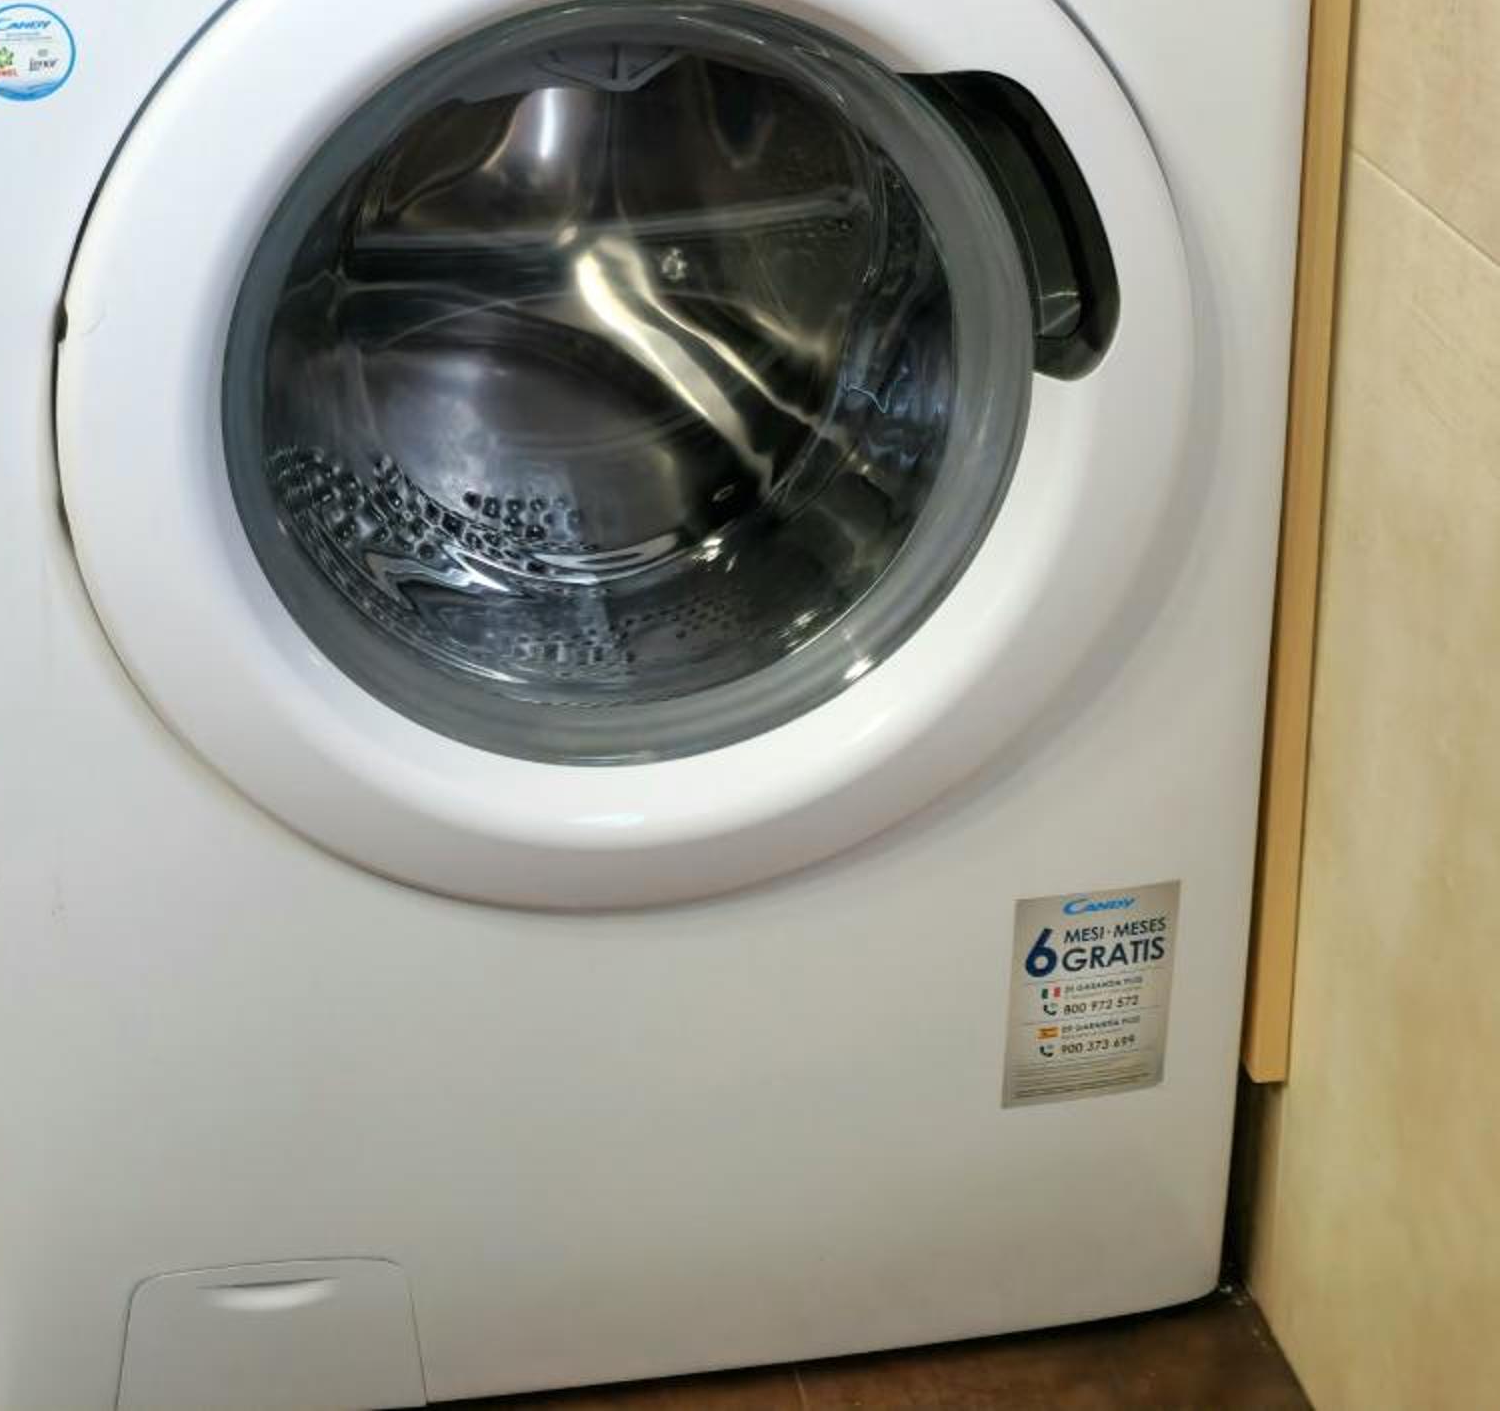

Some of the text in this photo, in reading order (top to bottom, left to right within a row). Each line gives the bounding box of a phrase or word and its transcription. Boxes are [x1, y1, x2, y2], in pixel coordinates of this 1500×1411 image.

[1063, 917, 1167, 944] MESI MESES
[1025, 928, 1058, 978] 6
[1062, 936, 1166, 972] GRATIS
